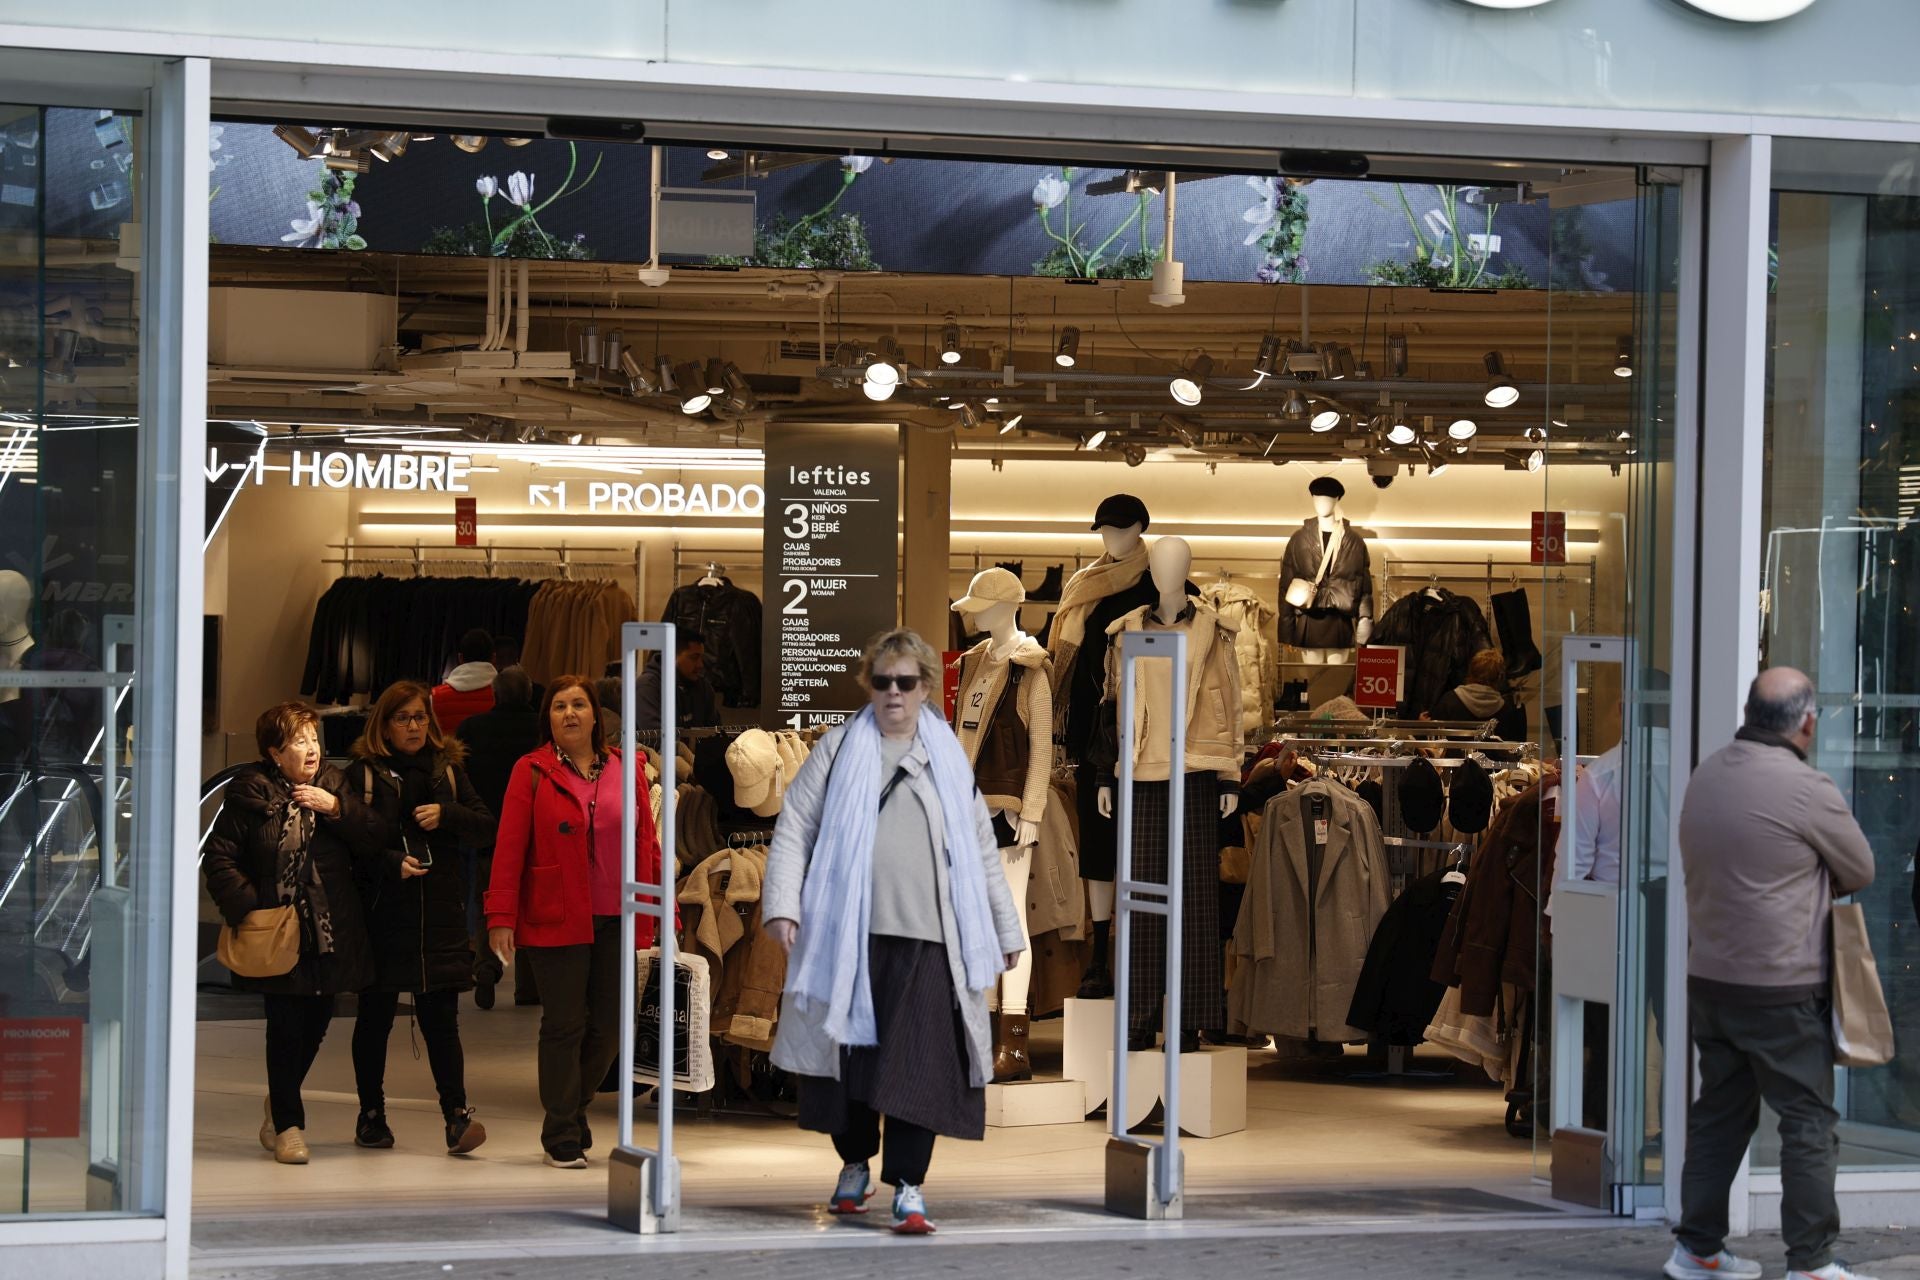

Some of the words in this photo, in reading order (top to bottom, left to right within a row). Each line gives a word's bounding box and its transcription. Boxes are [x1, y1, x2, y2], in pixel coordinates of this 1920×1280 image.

[292, 450, 471, 492] HOMBRE
[790, 465, 871, 485] lefties
[552, 481, 566, 513] 1
[588, 482, 765, 514] PROBADO
[813, 488, 847, 496] VALENCIA
[811, 502, 848, 515] NIÑOS
[783, 503, 809, 539] 3
[811, 521, 841, 533] BEBÉ
[783, 543, 811, 551] CAJAS
[783, 558, 841, 567] PROBADORES
[810, 579, 847, 590] MUJER
[782, 578, 808, 615] 2
[782, 618, 810, 627] CAJAS
[782, 633, 840, 643] PROBADORES
[781, 648, 861, 658] PERSONALIZACIÓN
[781, 663, 847, 673] DEVOLUCIONES
[781, 677, 829, 687] CAFETERÍA
[781, 693, 811, 702] ASEOS
[970, 692, 983, 708] 12
[786, 713, 802, 732] 1
[808, 714, 846, 725] MUJER
